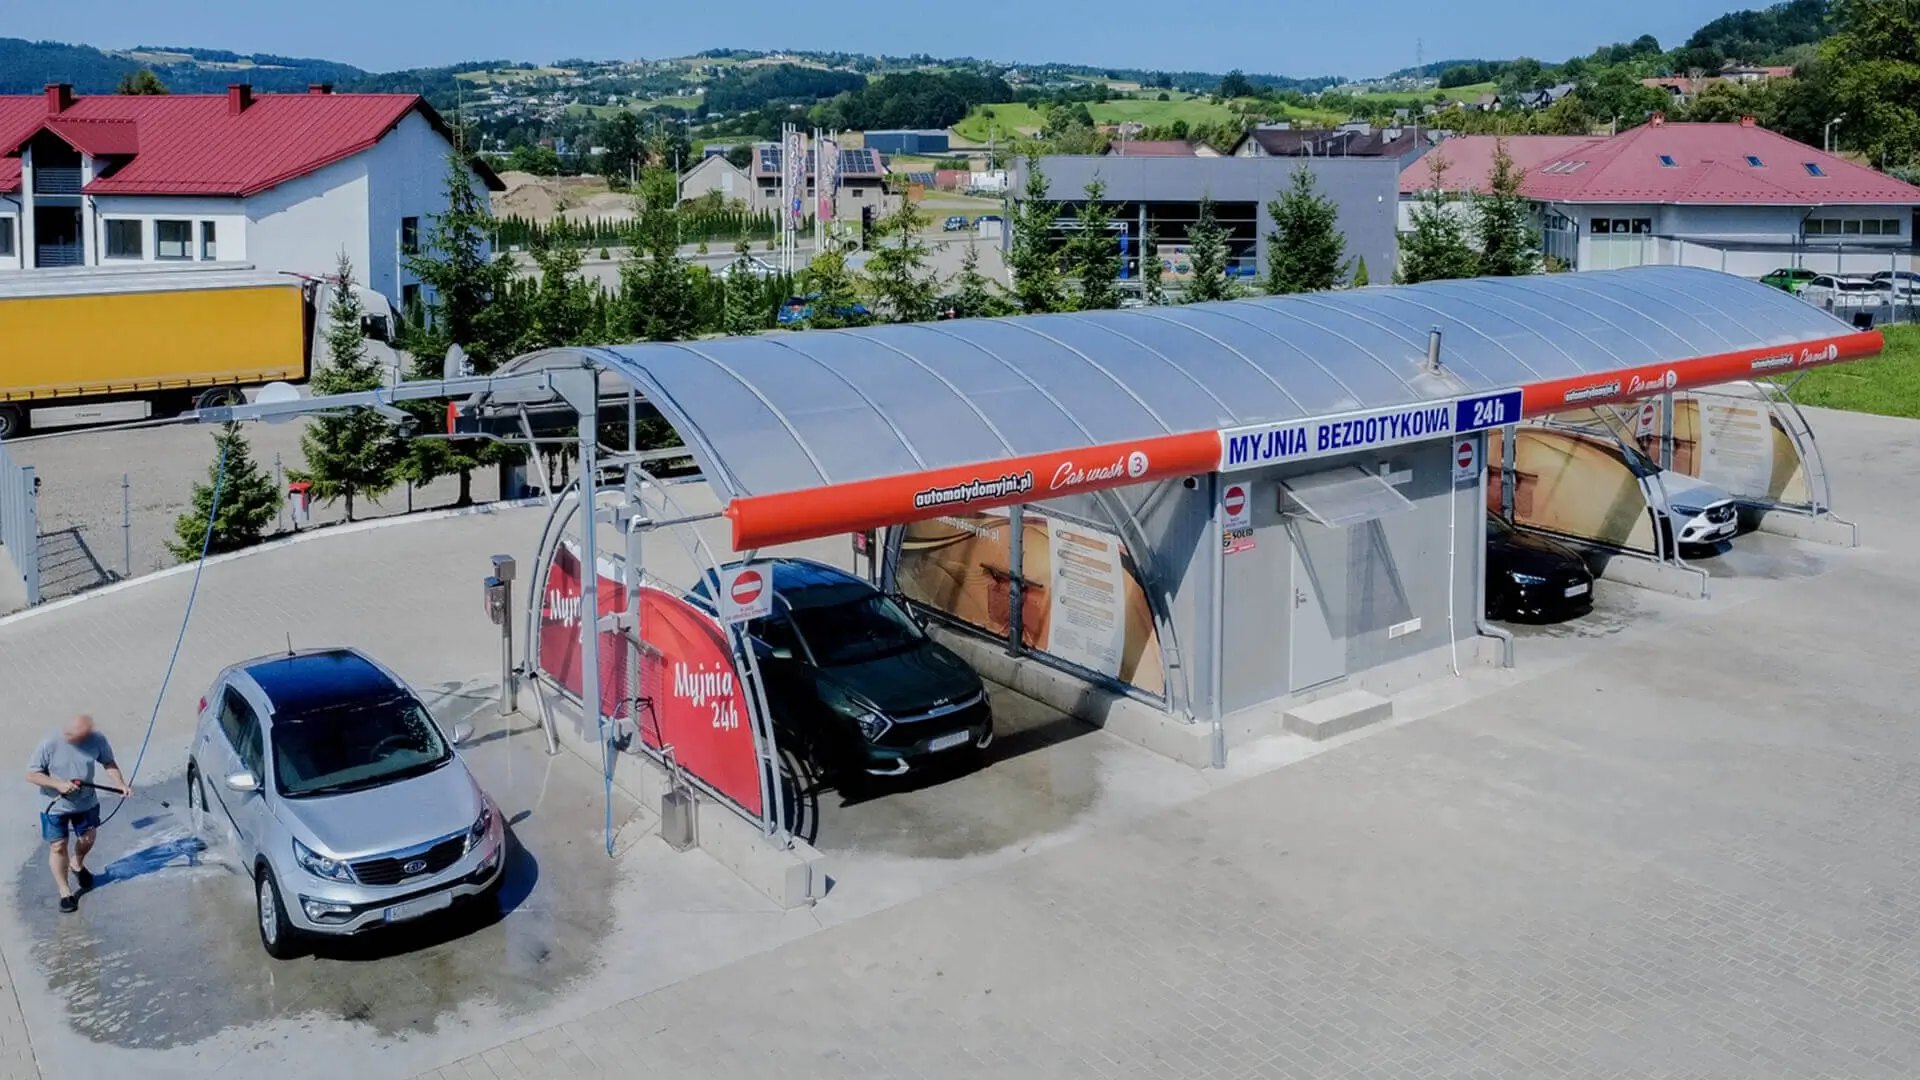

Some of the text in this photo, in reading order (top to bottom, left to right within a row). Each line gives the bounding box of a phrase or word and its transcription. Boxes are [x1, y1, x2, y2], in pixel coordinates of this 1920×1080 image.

[1473, 398, 1505, 427] 24h
[1229, 406, 1450, 465] MYJNIA BEZDOTYKOWA
[914, 472, 1033, 507] automatydomyjni.pl
[1050, 461, 1084, 490] Car
[1086, 455, 1124, 482] wash
[673, 662, 734, 707] Myjnia
[711, 702, 739, 731] 24h
